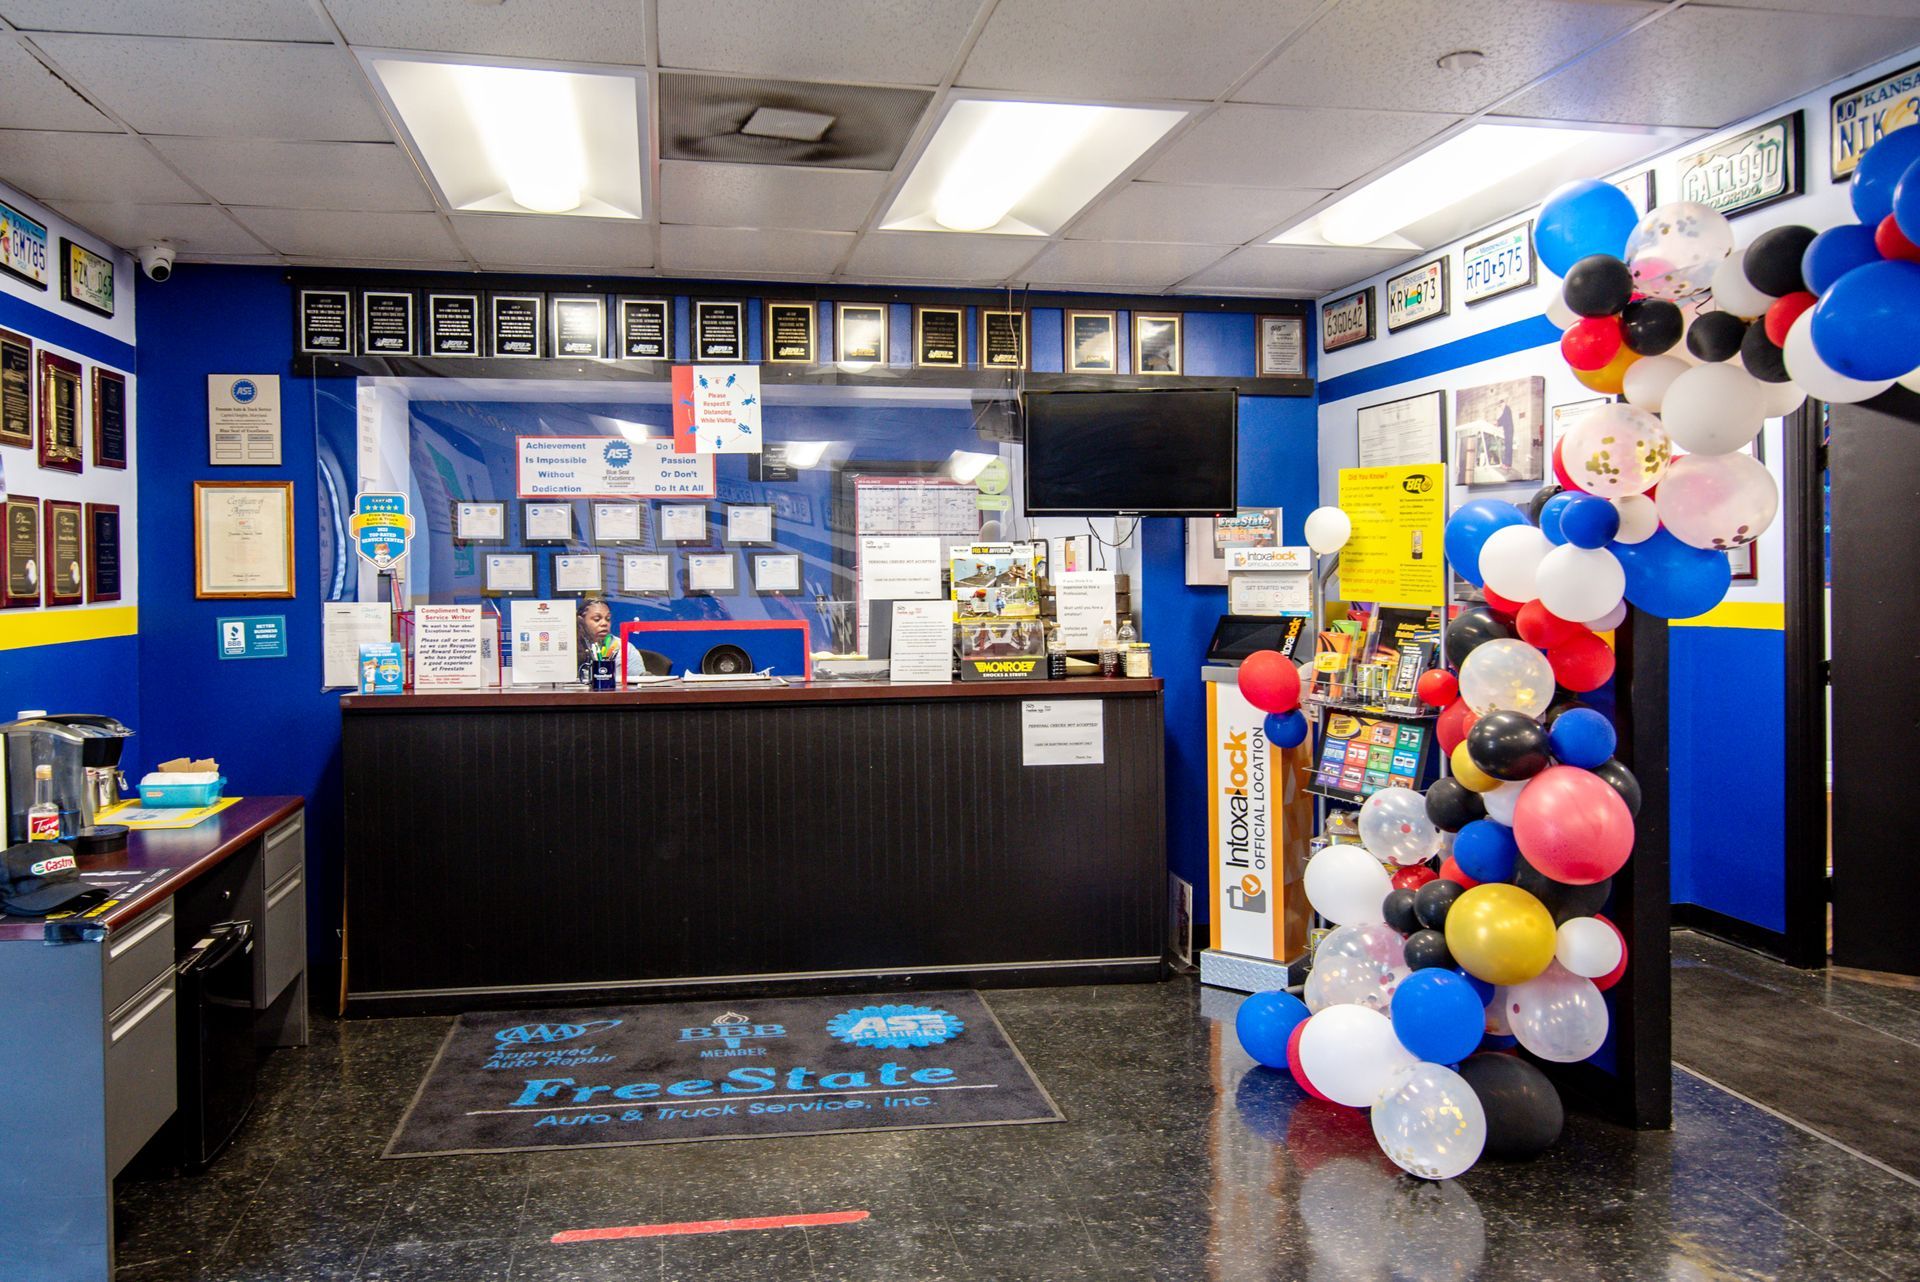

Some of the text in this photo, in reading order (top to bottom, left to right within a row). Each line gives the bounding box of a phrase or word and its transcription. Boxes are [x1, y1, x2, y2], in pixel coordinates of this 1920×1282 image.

[13, 229, 45, 271] GM785
[1467, 246, 1522, 290] RFD 575
[1390, 277, 1436, 314] KRY 873
[236, 387, 252, 395] ASE
[526, 442, 586, 450] Achievement
[606, 448, 629, 459] ASE
[537, 457, 587, 465] Impossible
[674, 470, 698, 478] Don't
[655, 484, 704, 492] Do It At All
[1247, 551, 1296, 561] Intoxalock
[974, 661, 1036, 672] MONROE
[1224, 727, 1249, 868] Intoxalock
[1252, 727, 1266, 870] OFFICIAL LOCATION
[679, 1024, 786, 1040] BBB
[848, 1014, 947, 1034] ASE
[509, 1024, 577, 1043] AAA
[851, 1028, 947, 1041] CERTIFIED
[488, 1045, 598, 1061] Approved
[700, 1048, 768, 1059] MEMBER
[481, 1053, 617, 1070] Auto Repair
[508, 1062, 958, 1107] FreeState
[533, 1113, 613, 1128] Auto
[619, 1109, 644, 1122] &
[658, 1104, 737, 1121] Truck
[748, 1100, 872, 1115] Service,
